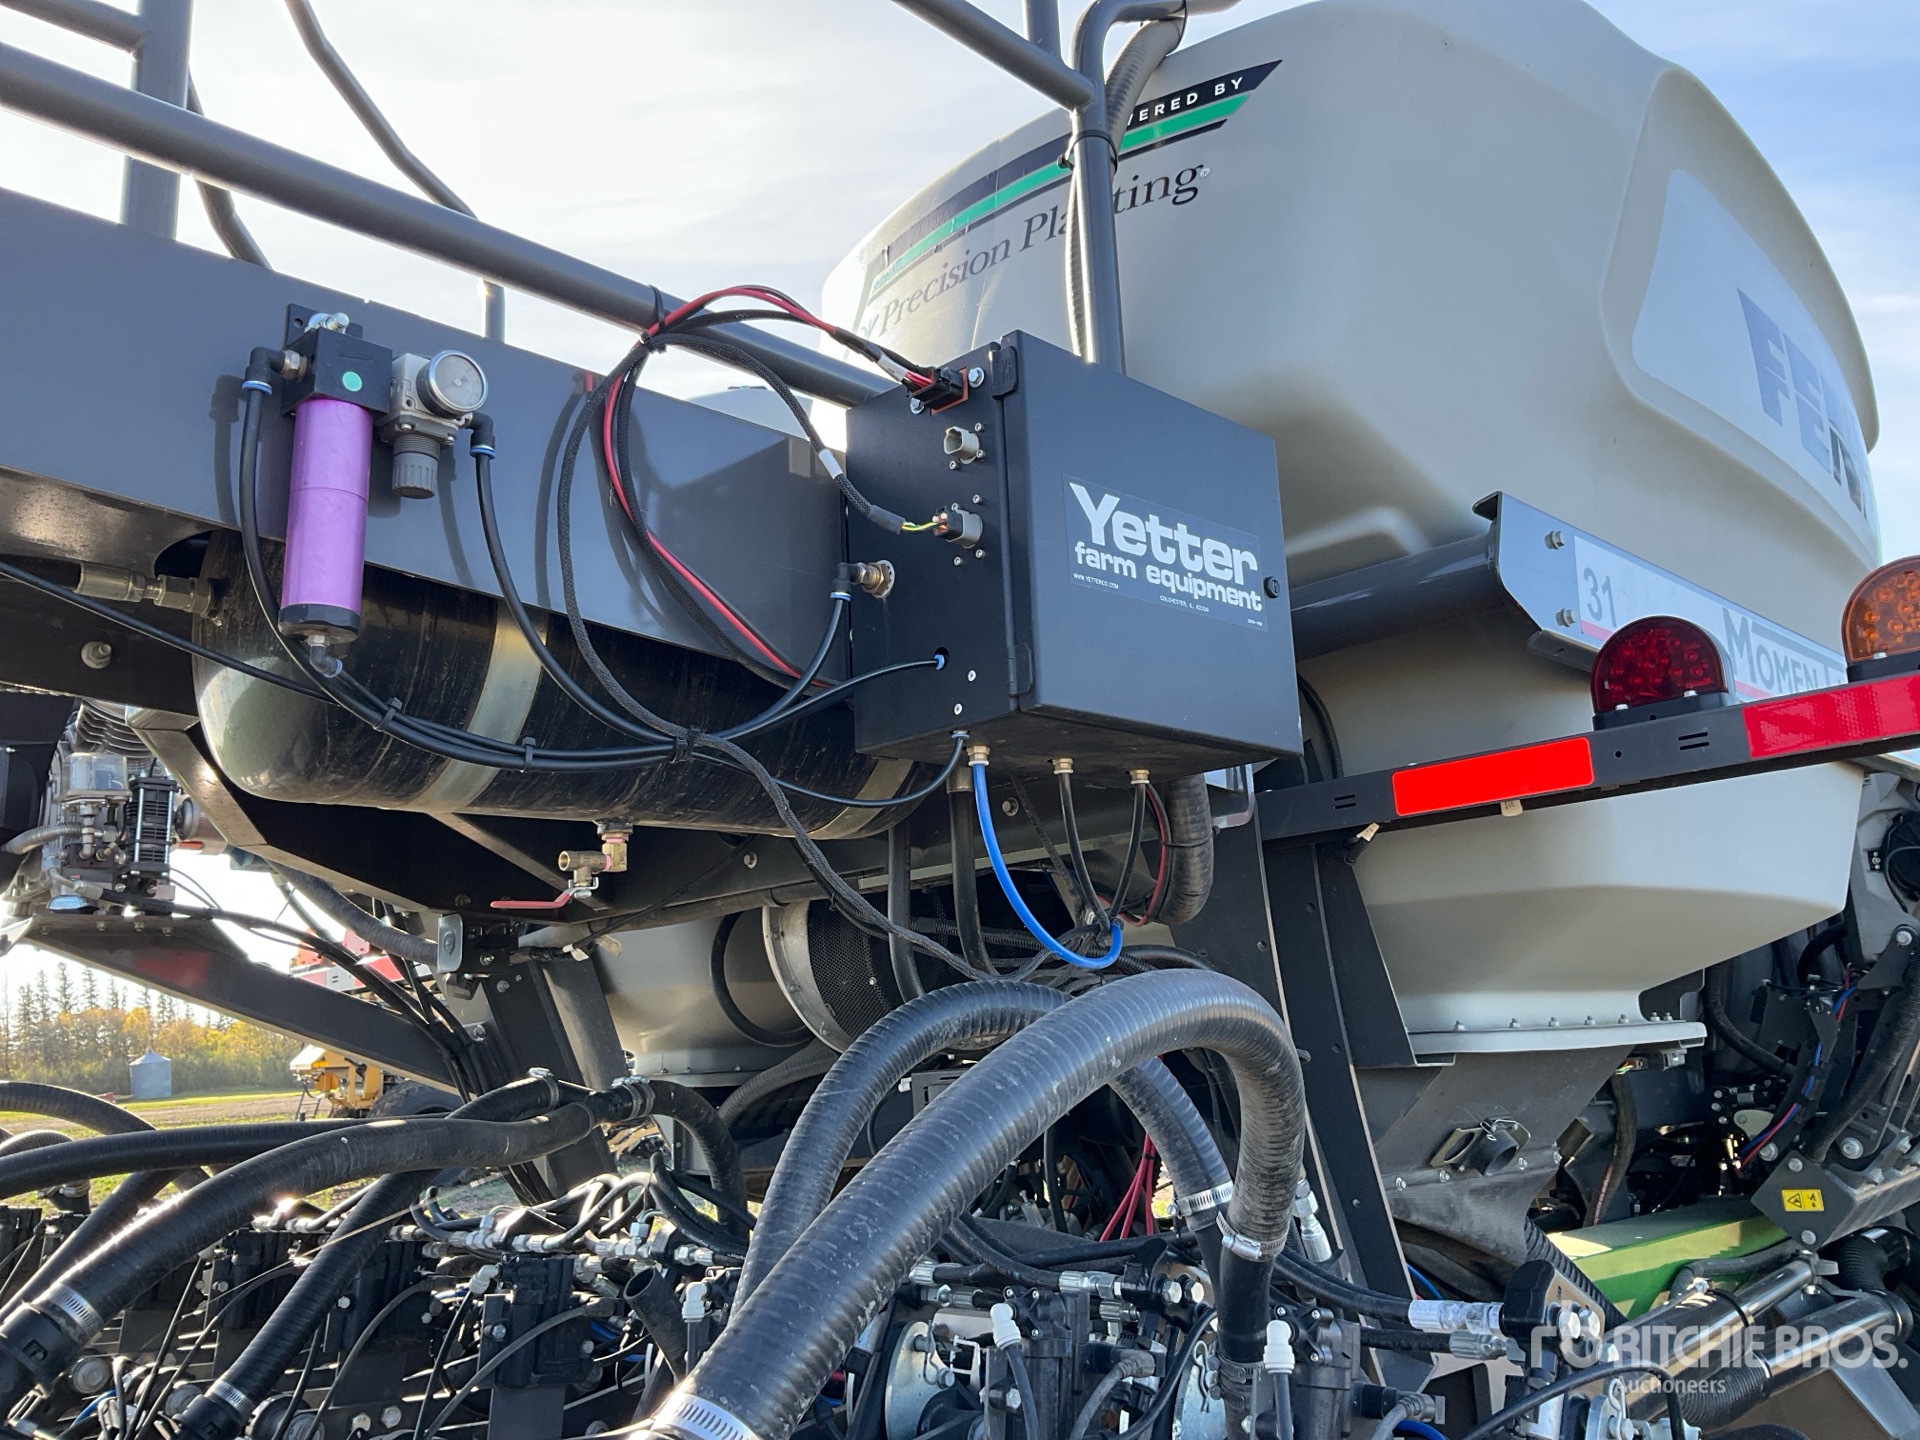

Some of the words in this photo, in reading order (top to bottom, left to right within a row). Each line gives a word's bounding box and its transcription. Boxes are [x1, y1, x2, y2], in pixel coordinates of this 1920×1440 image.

[1213, 76, 1243, 97] BY
[878, 238, 1011, 338] Precision
[1018, 164, 1204, 253] Plating
[1069, 482, 1258, 586] Yetter
[1074, 540, 1137, 579] farm
[1145, 564, 1263, 612] equipment
[1583, 566, 1617, 628] 31
